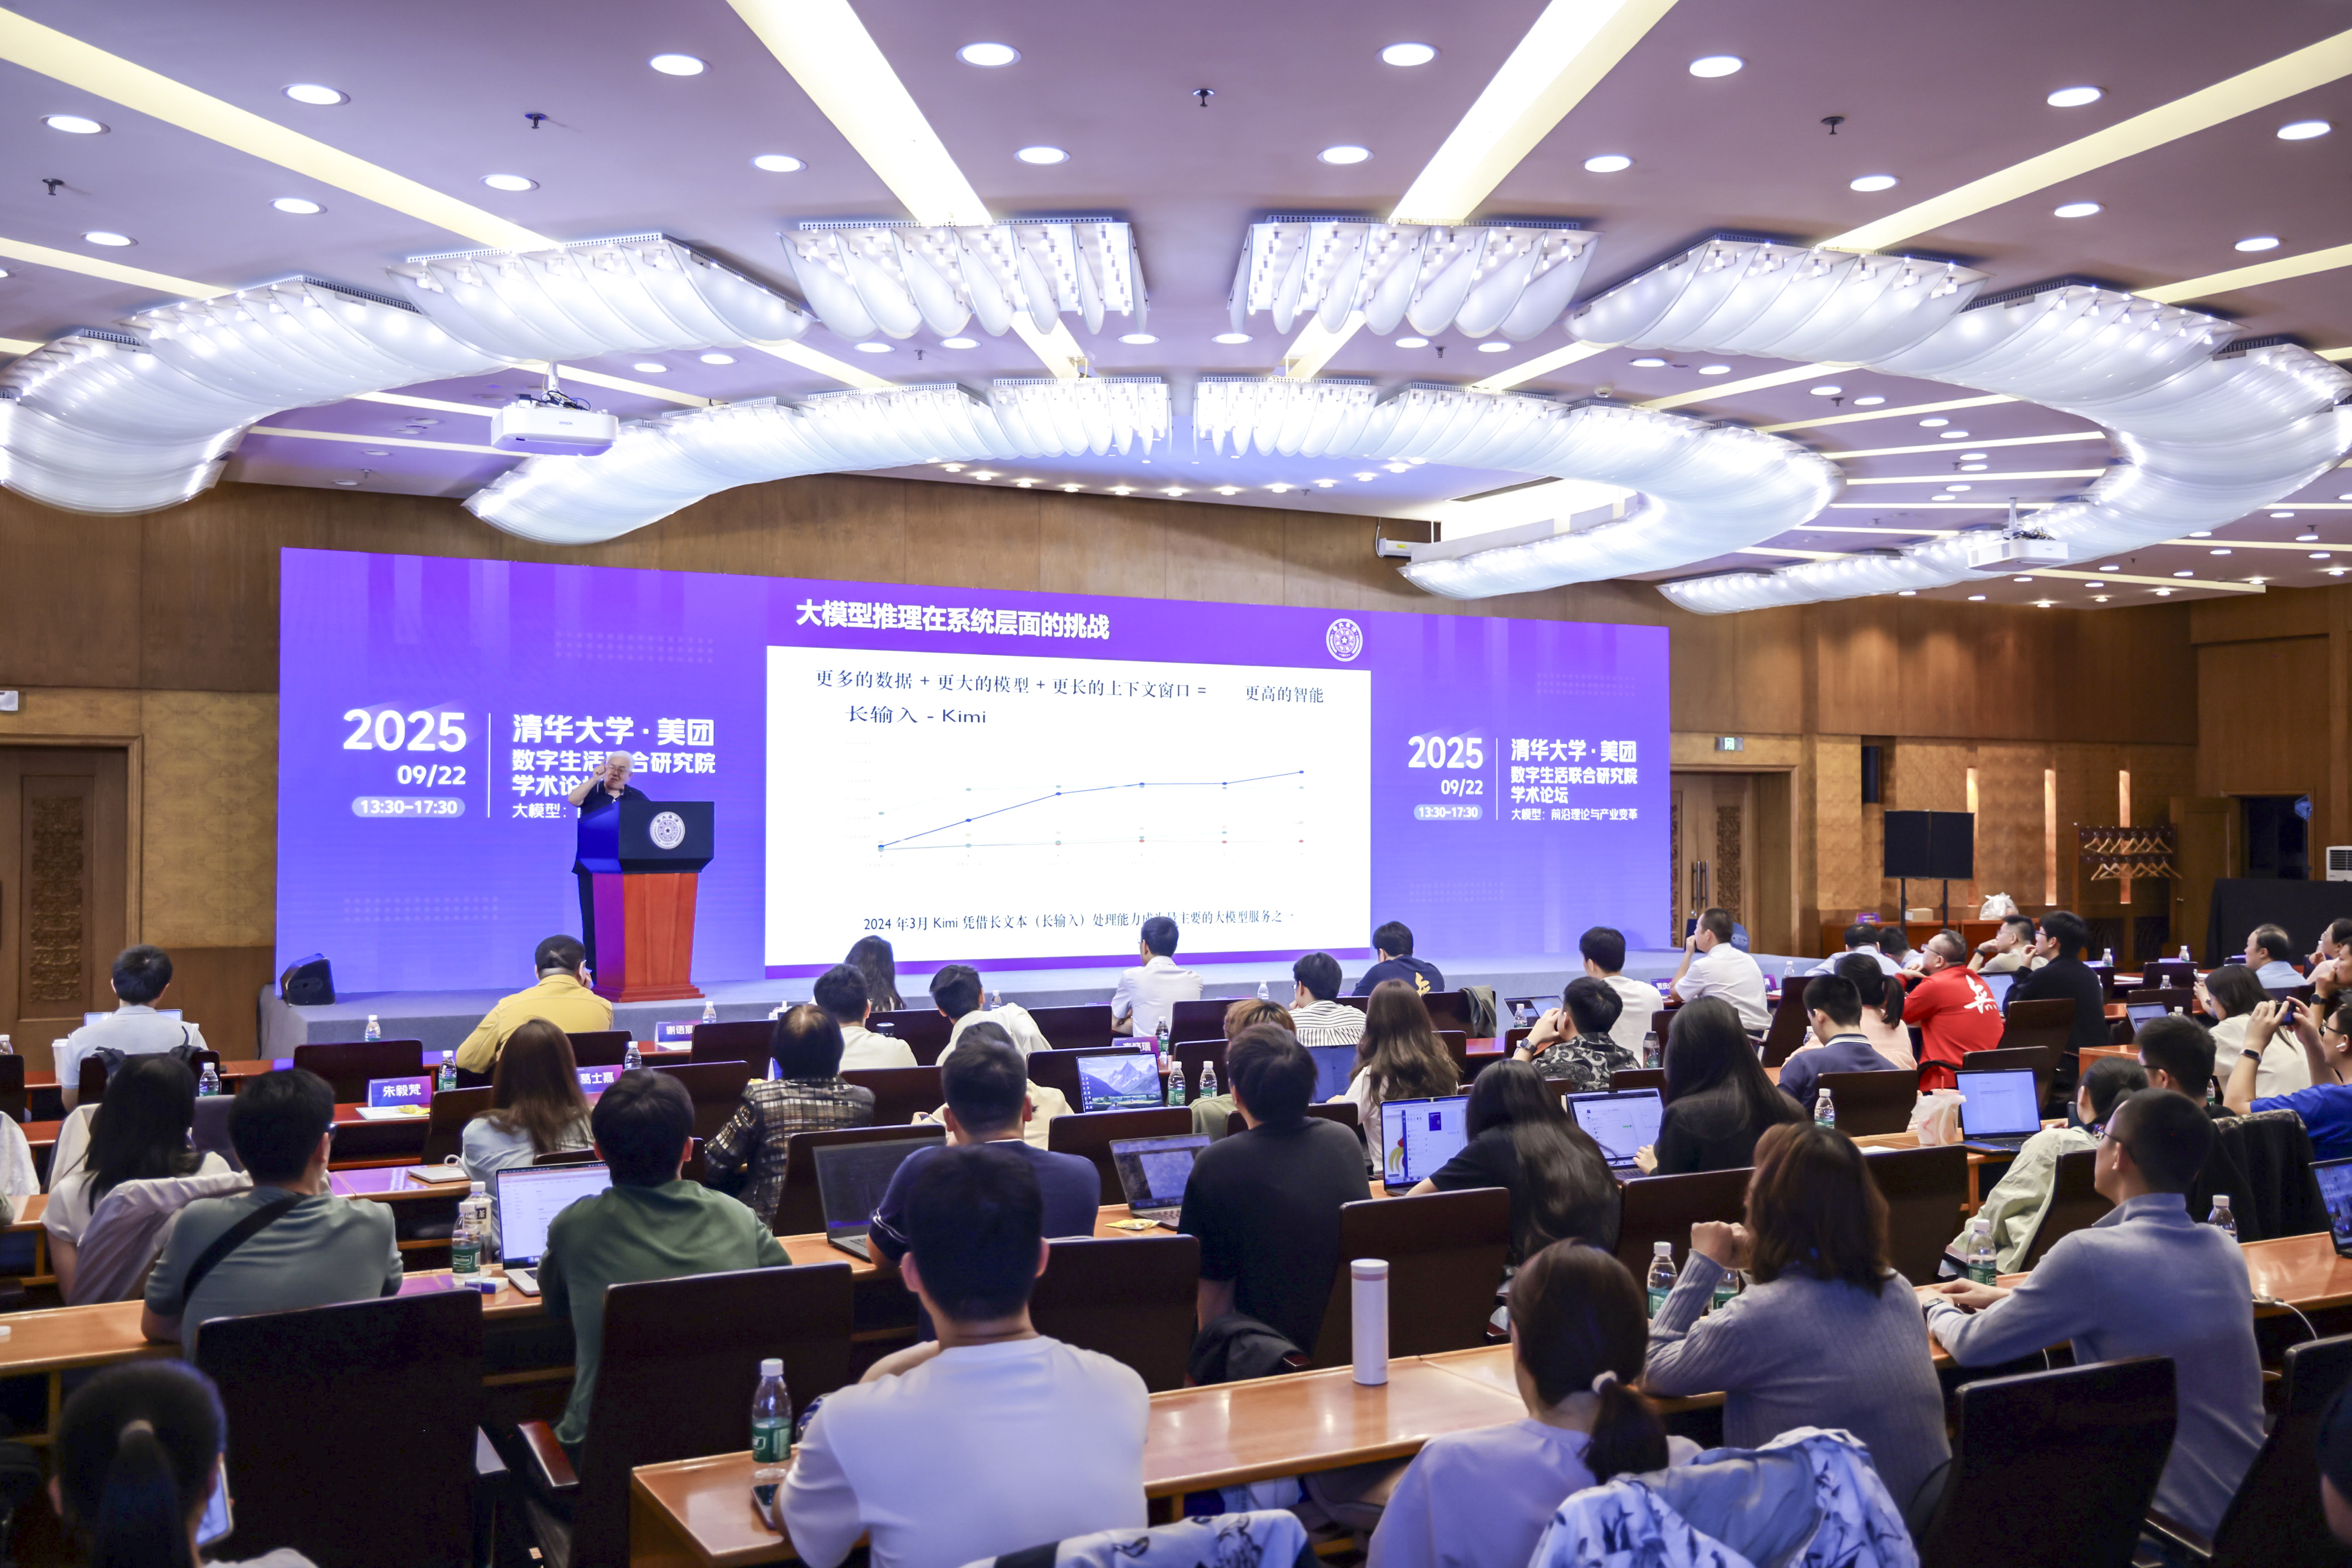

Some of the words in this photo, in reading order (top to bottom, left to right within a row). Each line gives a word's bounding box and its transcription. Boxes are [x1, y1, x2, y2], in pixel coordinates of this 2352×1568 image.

[796, 599, 1110, 640] 大模型推理在系统层面的挑战
[816, 670, 913, 691] 更多的数据
[937, 674, 1030, 694] 更大的模型
[1052, 677, 1190, 698] 更长的上下文窗口
[1245, 684, 1325, 704] 更高的智能
[846, 705, 919, 724] 长输入
[942, 708, 986, 724] Kimi
[343, 709, 467, 753] 2025
[513, 714, 714, 746] 清华大学·美团
[512, 748, 716, 774] 数字生活合研究院
[1408, 735, 1484, 769] 2025
[1511, 738, 1636, 763] 清华大学·美团
[397, 764, 466, 788] 09/22
[1511, 765, 1638, 785] 数字生活联合研究院
[512, 775, 590, 797] 学术论
[1441, 778, 1484, 797] 09/22
[1511, 785, 1569, 804] 学术论坛
[360, 800, 458, 814] 13:30-17:30
[1418, 807, 1479, 818] 13:30-17:30
[1511, 808, 1638, 821] 大模型：前沿理论与产业变革
[864, 918, 892, 930] 2024
[896, 916, 927, 931] 年3月
[933, 917, 958, 929] Kimi
[383, 1084, 422, 1098] 朱毅梵
